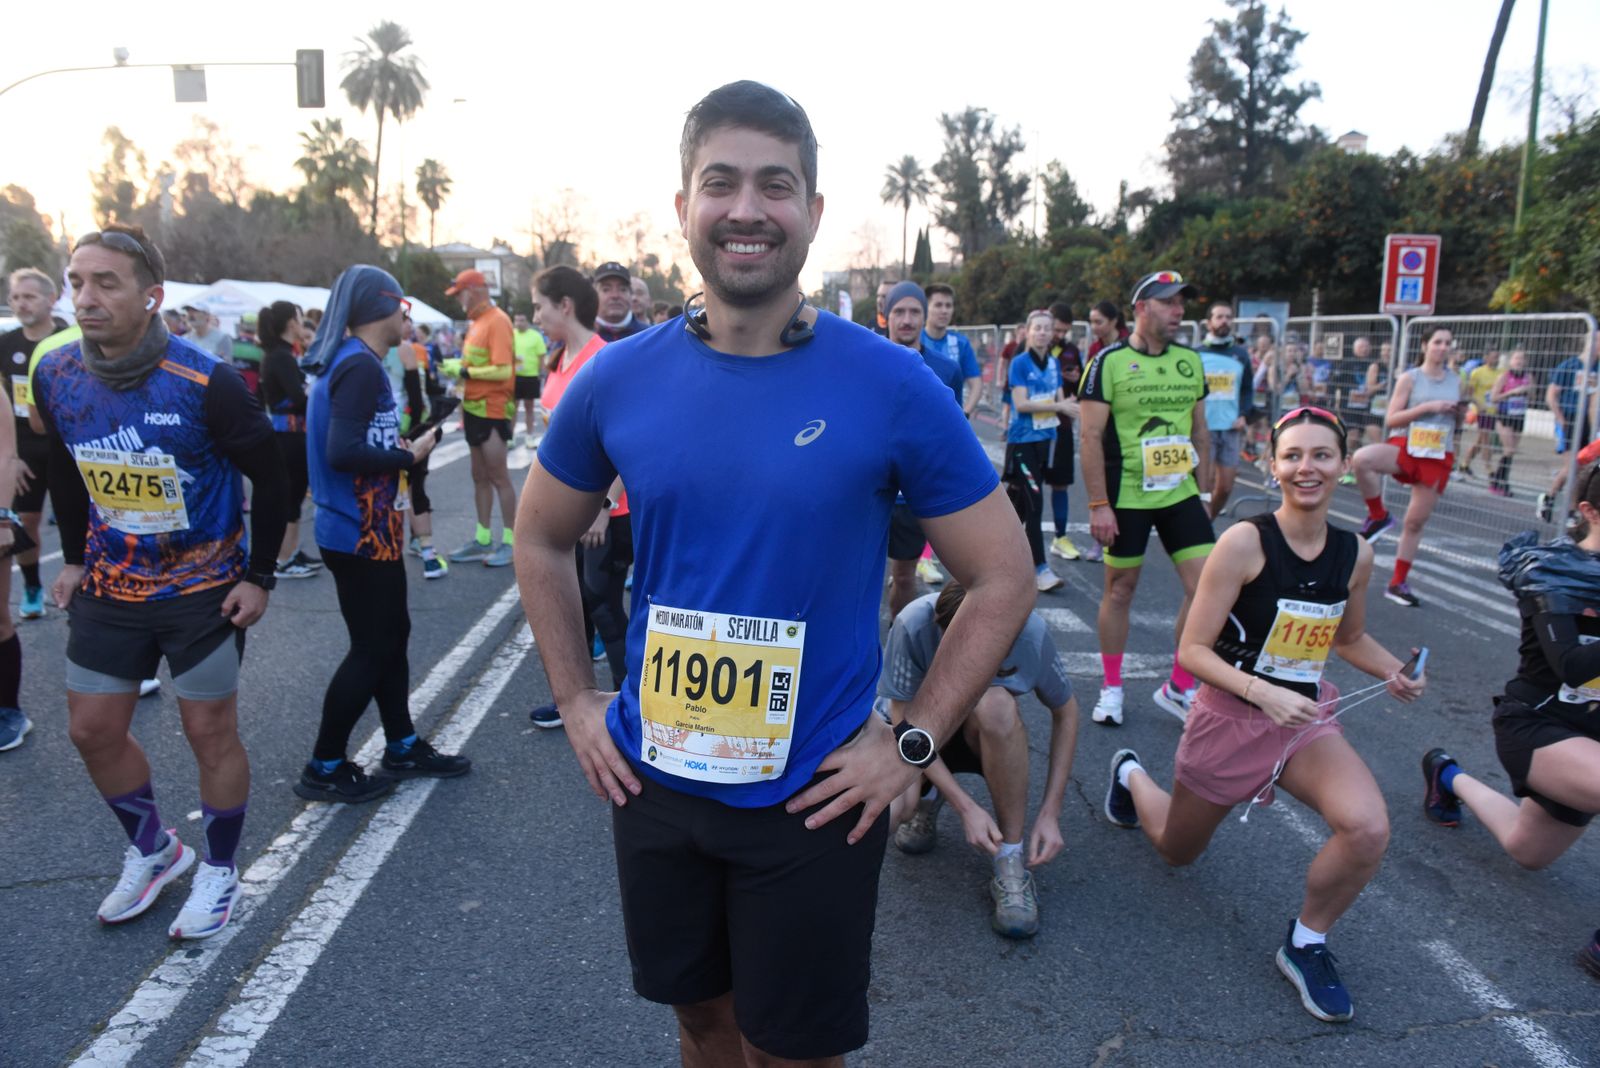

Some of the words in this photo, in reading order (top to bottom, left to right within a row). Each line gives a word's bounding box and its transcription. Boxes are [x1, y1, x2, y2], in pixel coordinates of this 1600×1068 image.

[144, 412, 181, 426] HOKA
[1152, 449, 1188, 466] 9534
[88, 469, 163, 498] 12475
[656, 610, 669, 625] MEDIO
[670, 612, 704, 631] MARATÓN
[727, 617, 779, 642] SEVILLA
[651, 646, 763, 707] 11901
[685, 703, 707, 714] Pablo
[684, 759, 708, 772] HOKA
